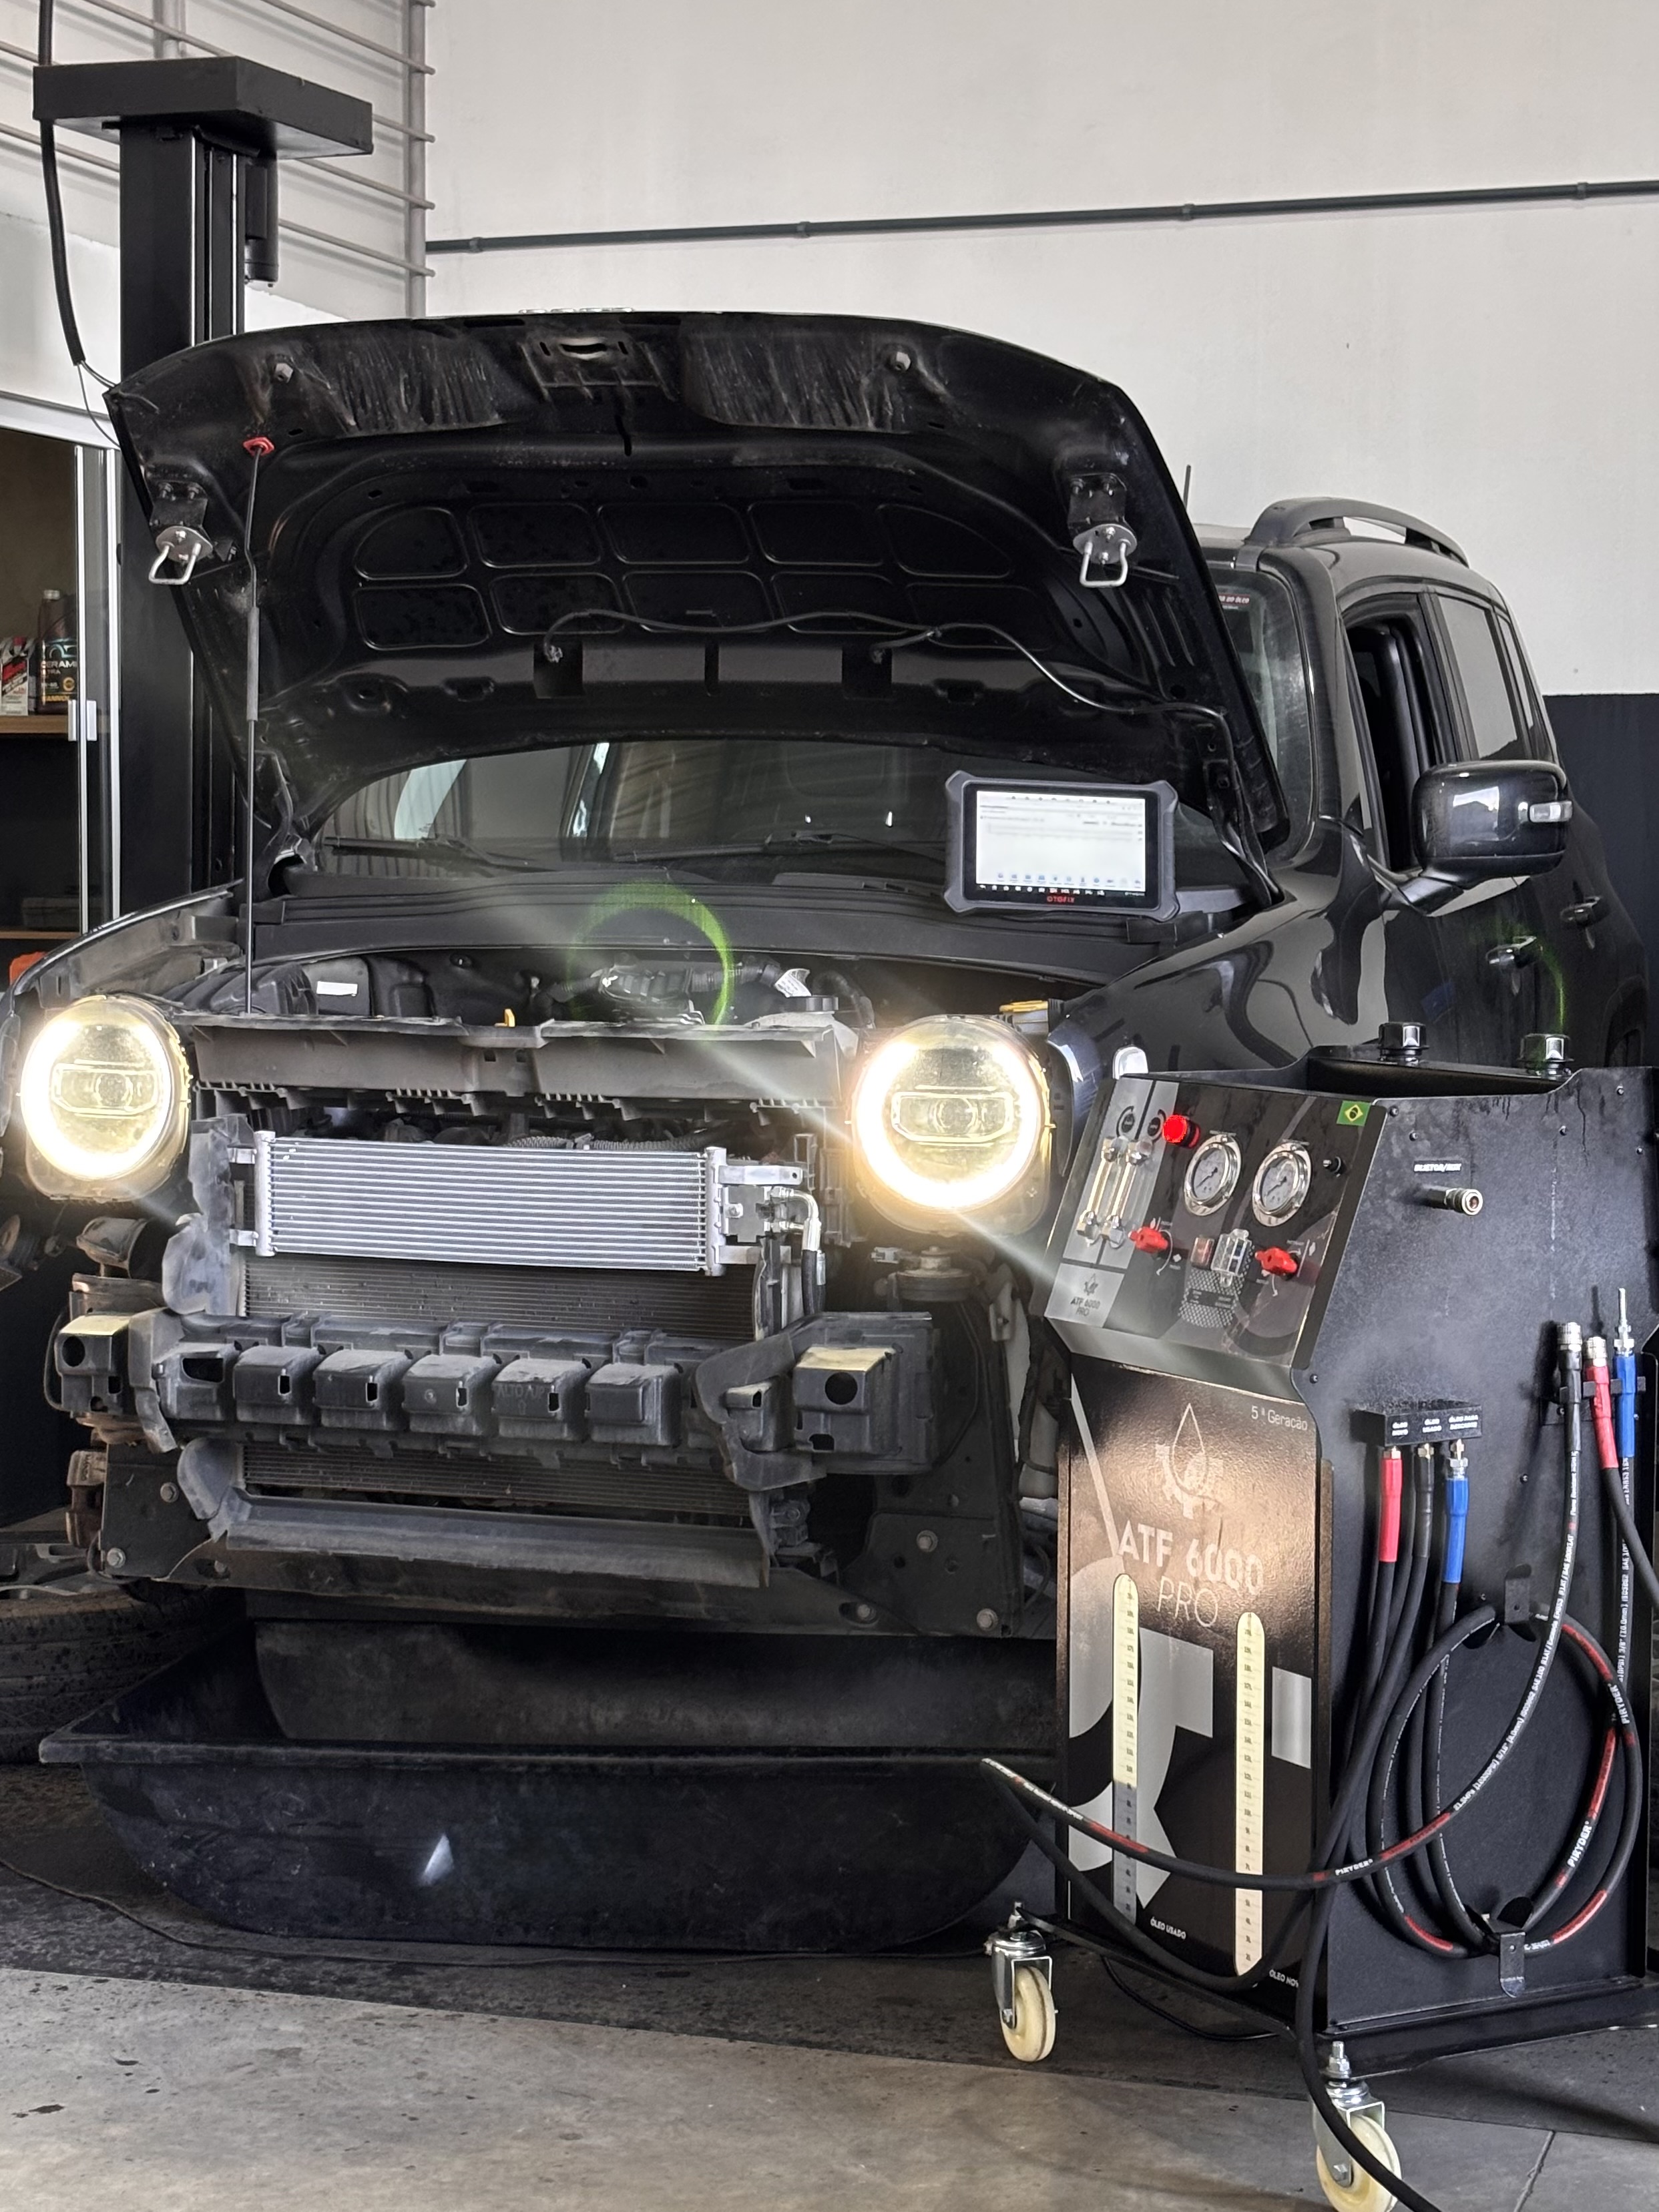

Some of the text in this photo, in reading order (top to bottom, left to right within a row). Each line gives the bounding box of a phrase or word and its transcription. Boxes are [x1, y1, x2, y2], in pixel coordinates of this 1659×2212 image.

[1118, 1520, 1264, 1596] ATF 6000
[1157, 1575, 1218, 1627] PRO
[1567, 1824, 1592, 1868] PIRYDER
[1150, 1916, 1186, 1940] ÓLEO USADO
